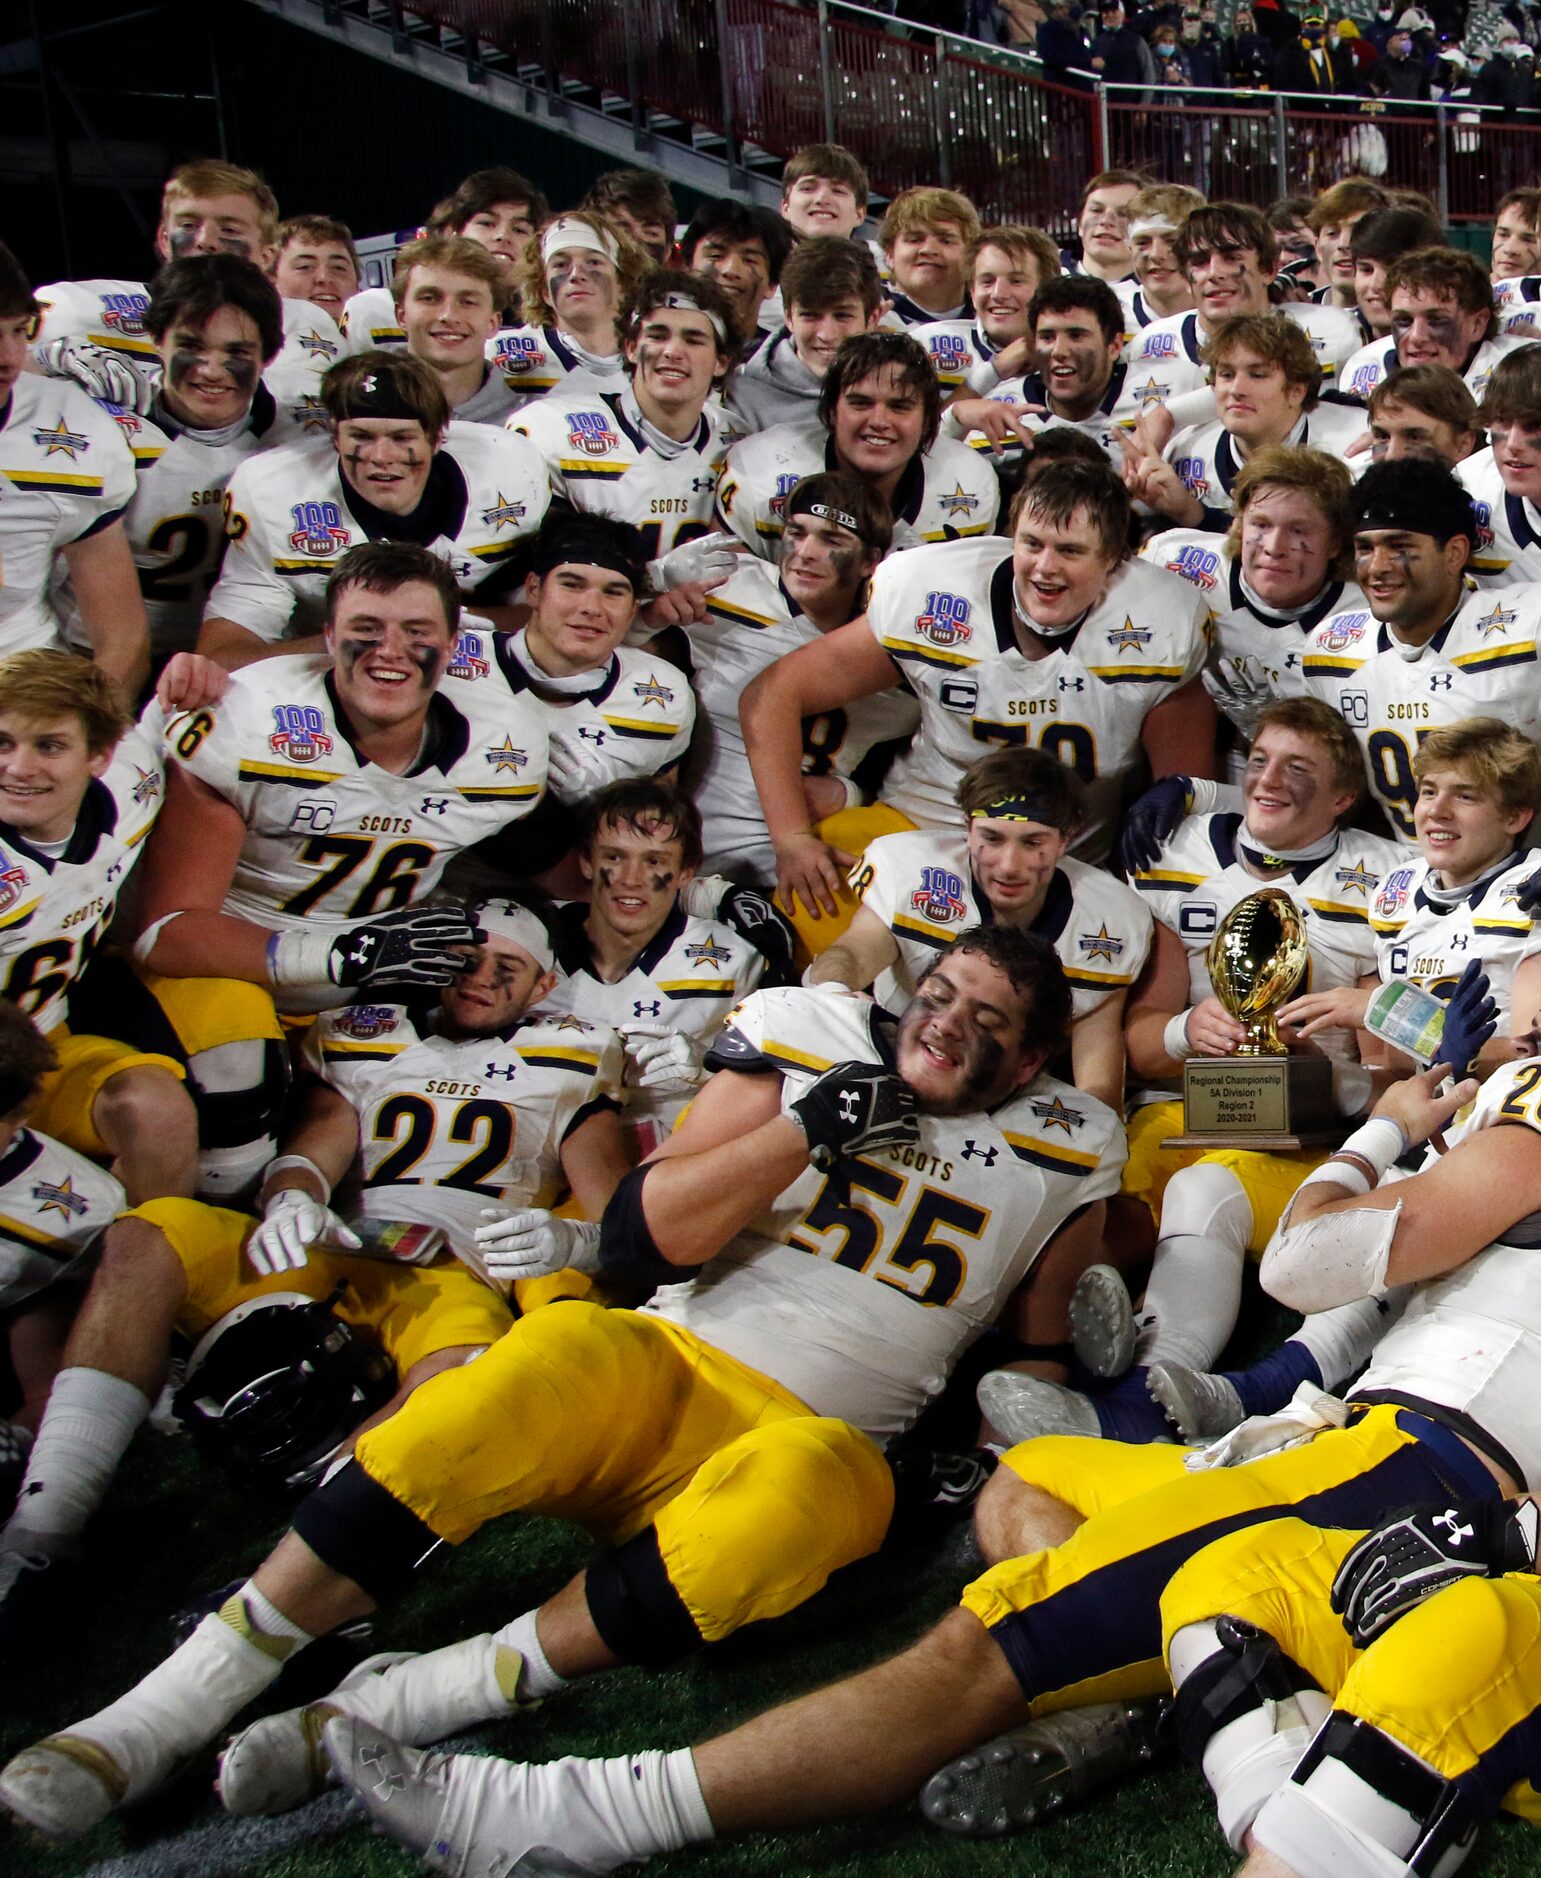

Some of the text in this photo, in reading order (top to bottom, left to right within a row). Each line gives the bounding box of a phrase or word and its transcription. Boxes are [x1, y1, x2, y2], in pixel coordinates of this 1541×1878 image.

[497, 337, 540, 358] 100
[929, 335, 966, 357] 100
[567, 412, 609, 434] 100
[290, 501, 342, 530] 100
[651, 499, 689, 514] SCOTS
[1174, 545, 1220, 576] 100
[923, 591, 971, 624] 100
[1329, 612, 1371, 631] 100
[946, 684, 976, 710] C
[1008, 698, 1058, 716] SCOTS
[272, 704, 325, 734] 100
[1387, 703, 1429, 719] SCOTS
[359, 815, 412, 834] SCOTS
[279, 833, 438, 919] 76
[920, 867, 962, 901] 100
[1382, 867, 1416, 893] 100
[61, 897, 103, 929] SCOTS
[1181, 906, 1216, 934] C
[1391, 948, 1407, 975] C
[1413, 958, 1445, 975] SCOTS
[425, 1080, 482, 1097] SCOTS
[1190, 1075, 1281, 1087] Regional Championship
[1210, 1088, 1262, 1098] 5A Division 1
[1216, 1113, 1256, 1122] 2020-2021
[1218, 1101, 1254, 1112] Region 2
[362, 1091, 518, 1199] 22
[890, 1144, 955, 1182] SCOTS
[784, 1152, 993, 1308] 55
